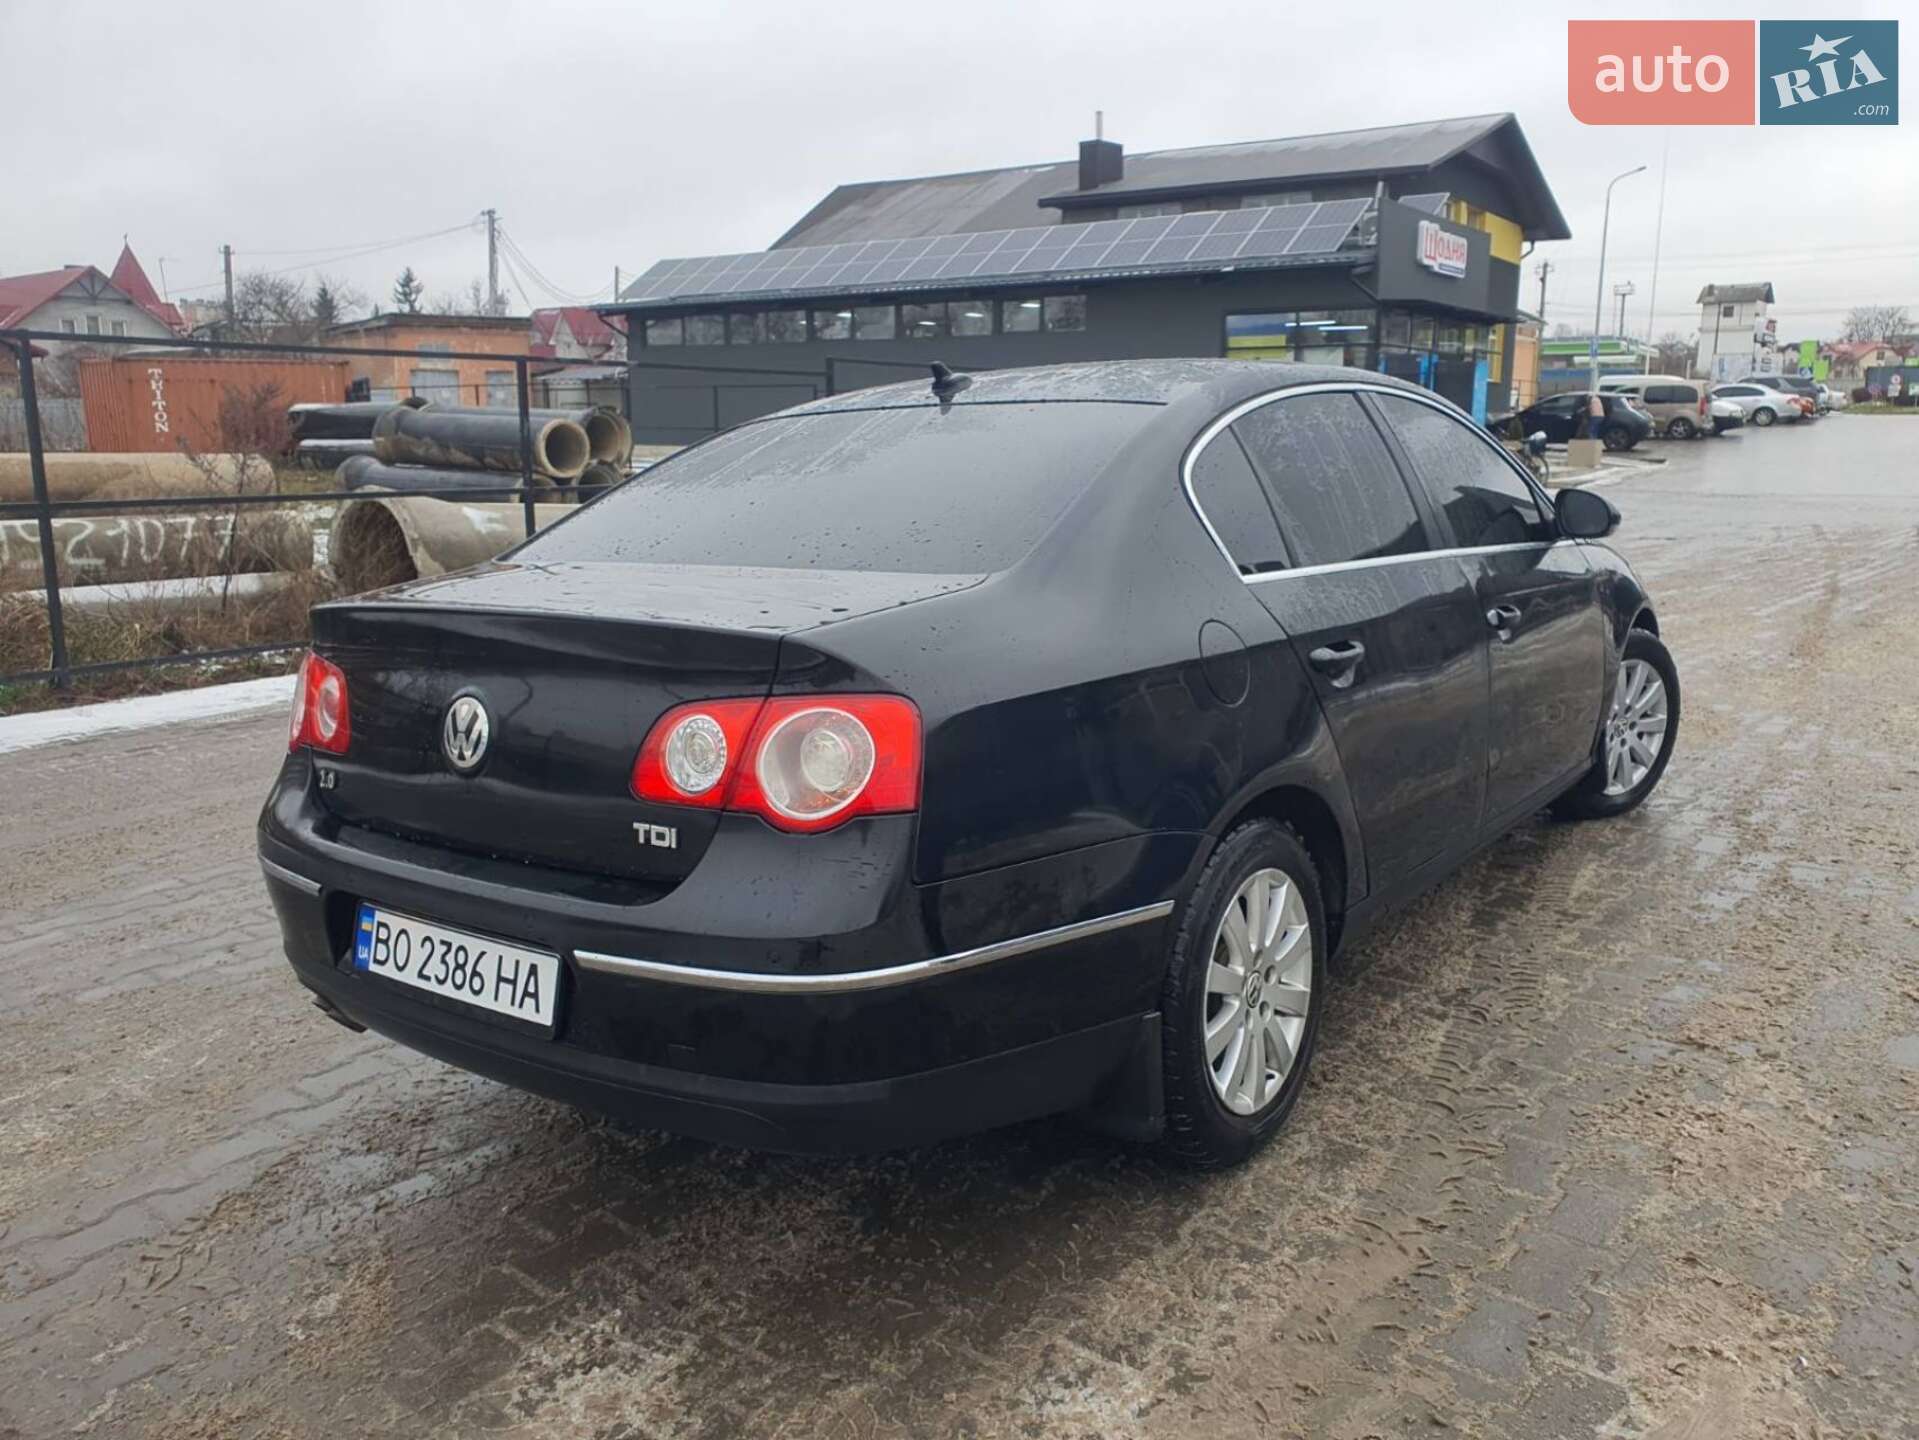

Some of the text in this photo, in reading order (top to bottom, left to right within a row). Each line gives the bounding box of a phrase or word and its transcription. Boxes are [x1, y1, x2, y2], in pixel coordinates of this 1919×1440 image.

[148, 367, 169, 433] TRITON
[632, 821, 678, 849] TDI
[357, 944, 369, 961] UA
[417, 935, 488, 997] 2386
[493, 953, 541, 1015] HA
